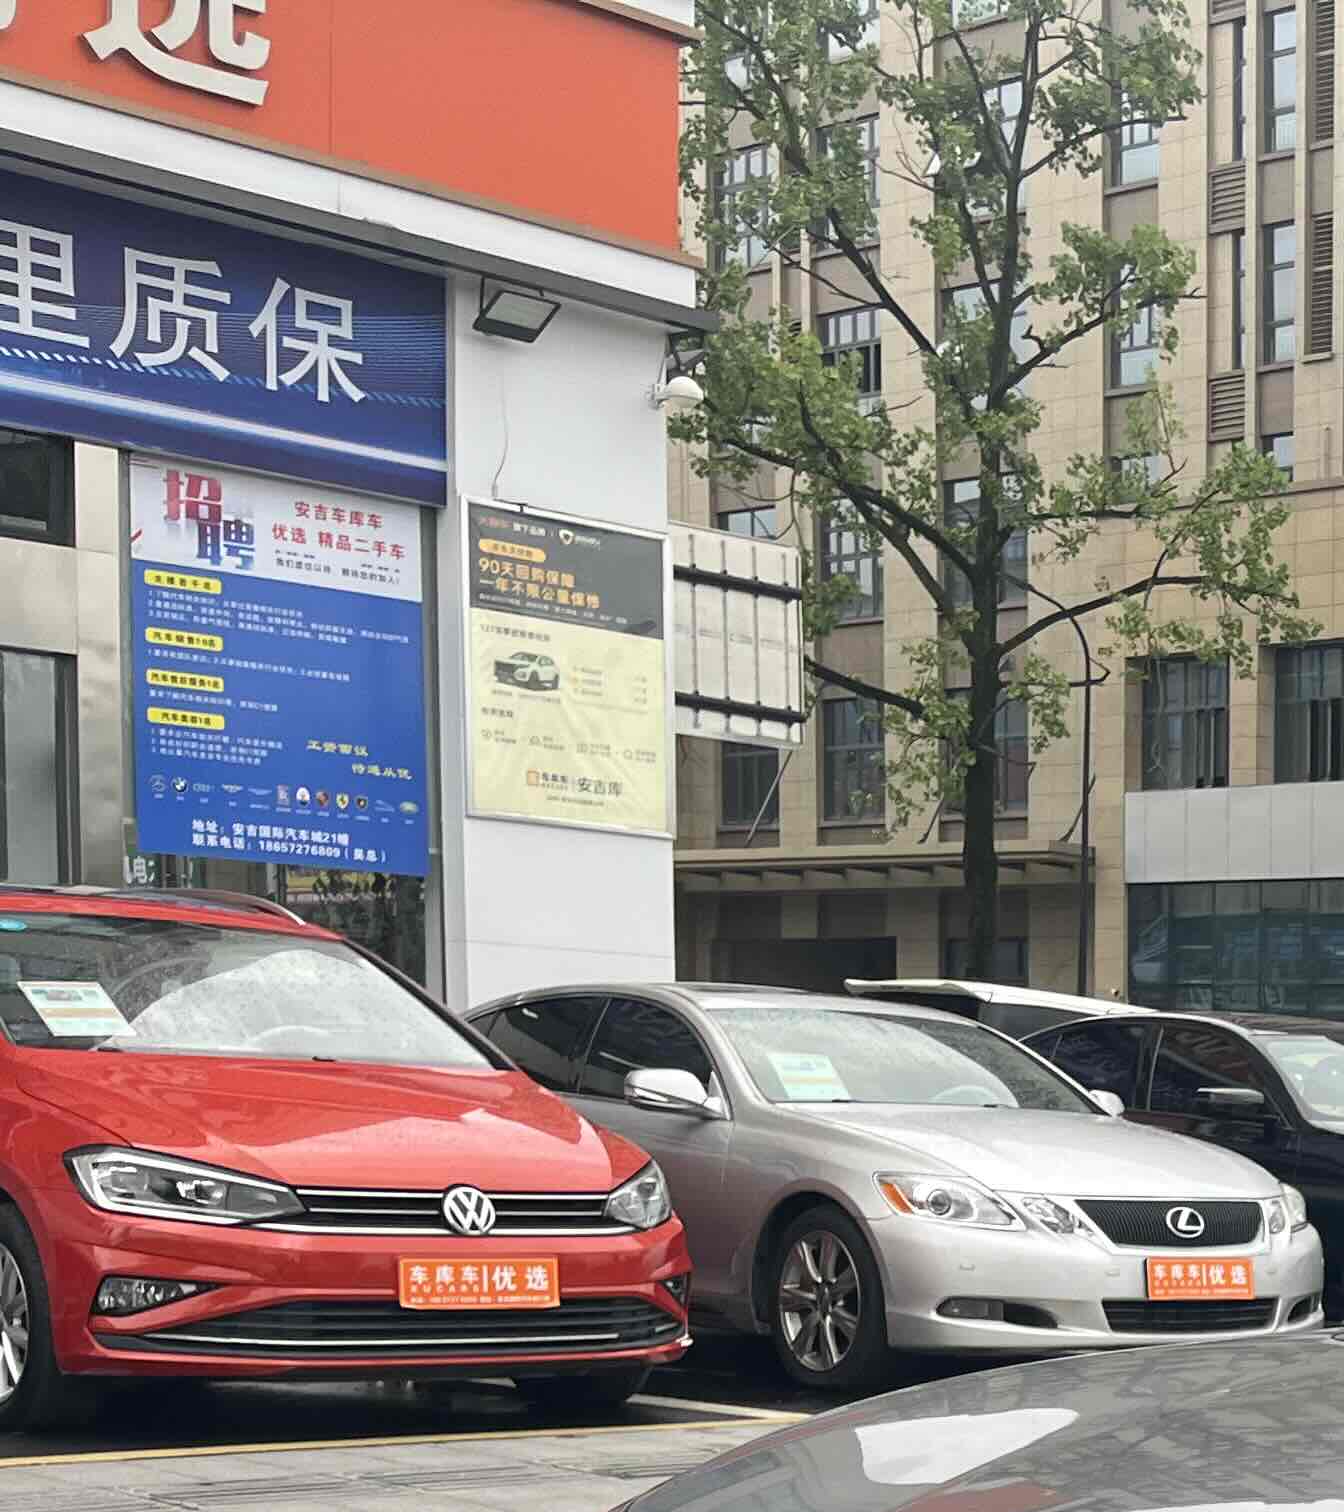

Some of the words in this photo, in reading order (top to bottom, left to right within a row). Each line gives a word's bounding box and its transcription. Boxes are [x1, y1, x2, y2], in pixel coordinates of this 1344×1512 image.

[0, 217, 367, 404] 里质保
[163, 469, 256, 571] 招聘
[271, 523, 308, 546] 优选
[318, 530, 406, 562] 精品二手车
[294, 501, 384, 530] 安吉车库车
